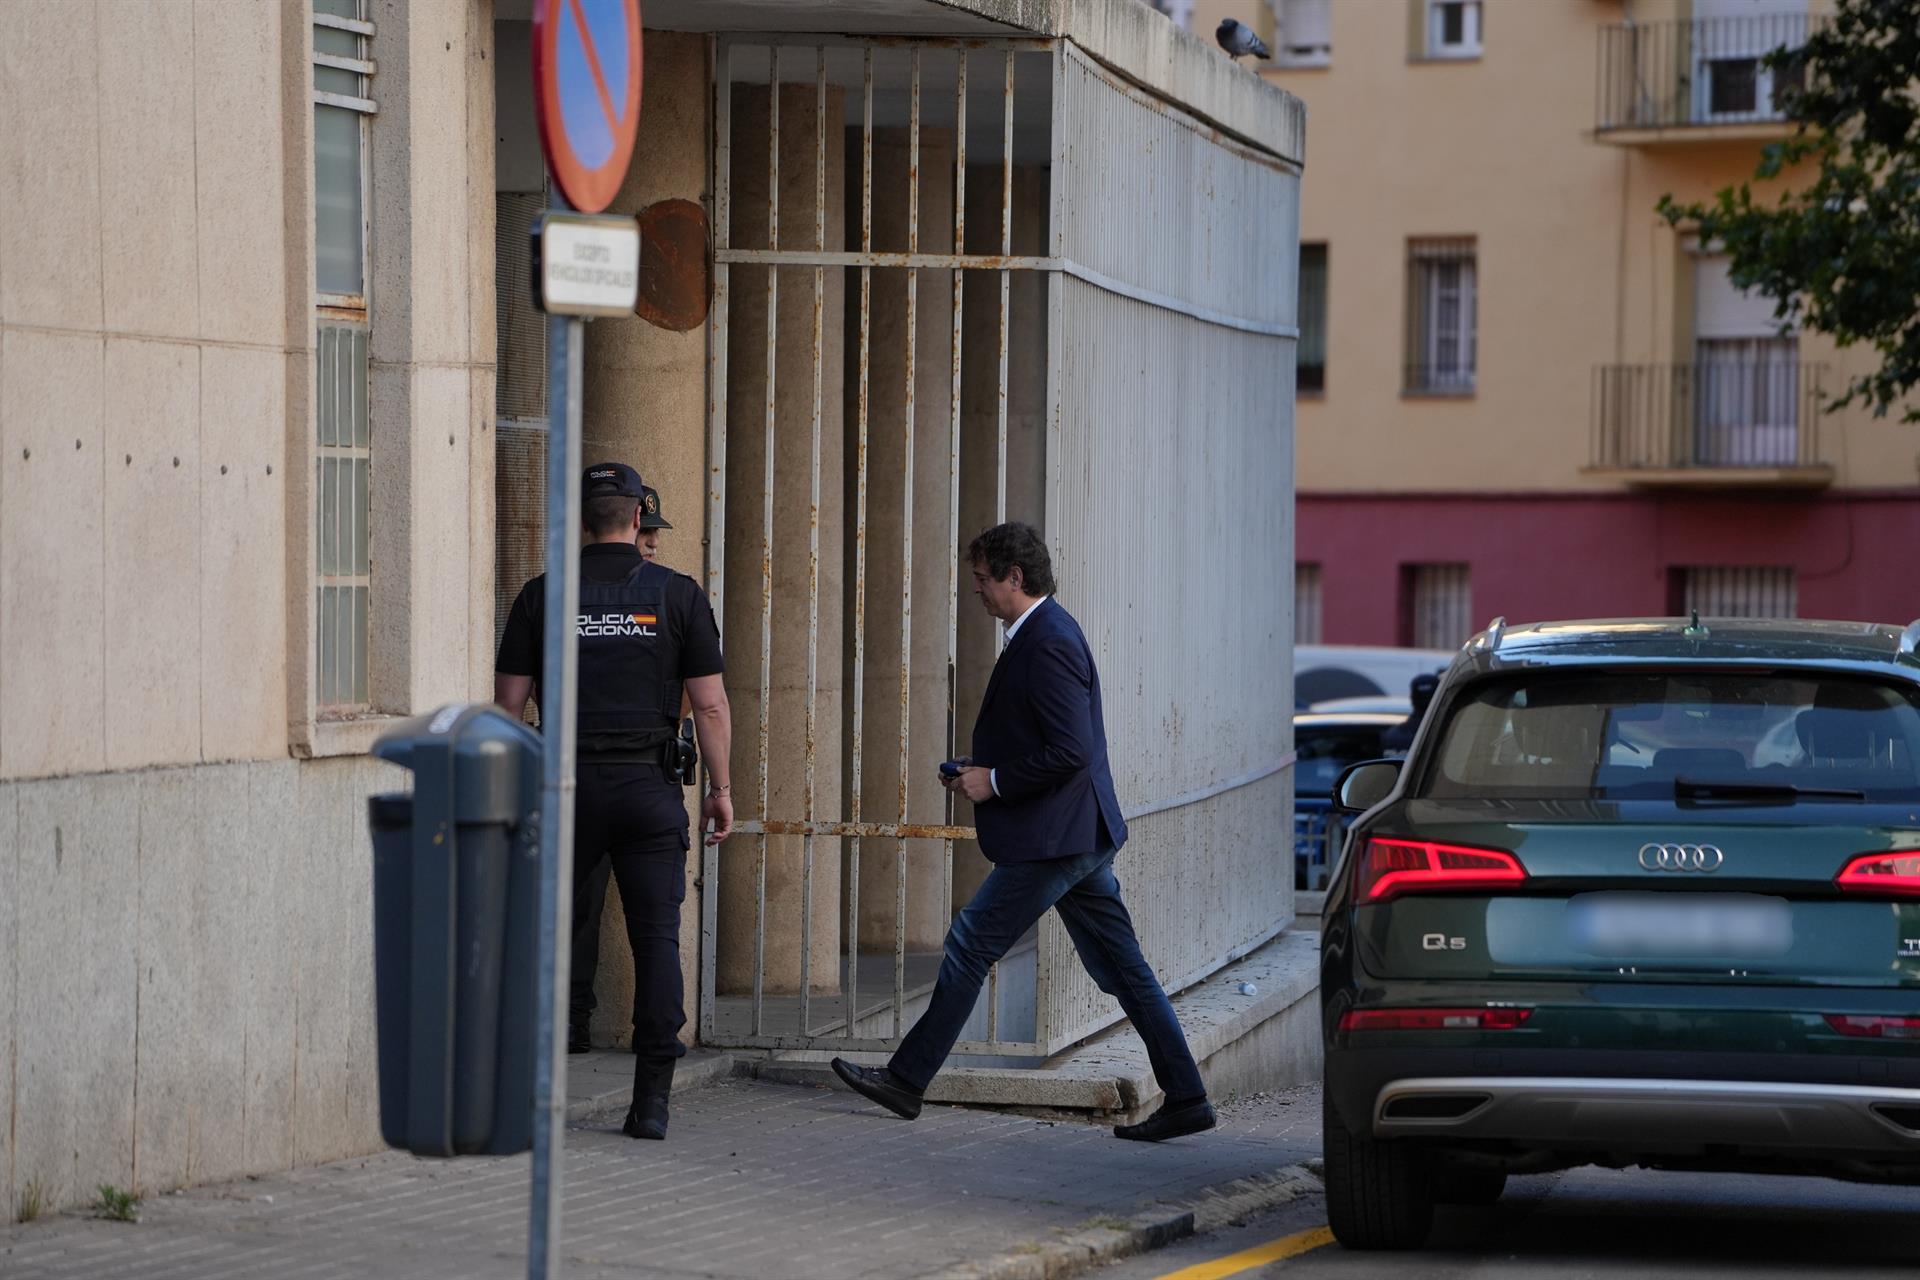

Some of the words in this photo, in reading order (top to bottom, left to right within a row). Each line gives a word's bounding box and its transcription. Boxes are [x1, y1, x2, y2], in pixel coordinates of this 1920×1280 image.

[576, 614, 637, 625] OLICIA
[576, 625, 657, 637] ACIONAL
[1423, 933, 1466, 950] Q5
